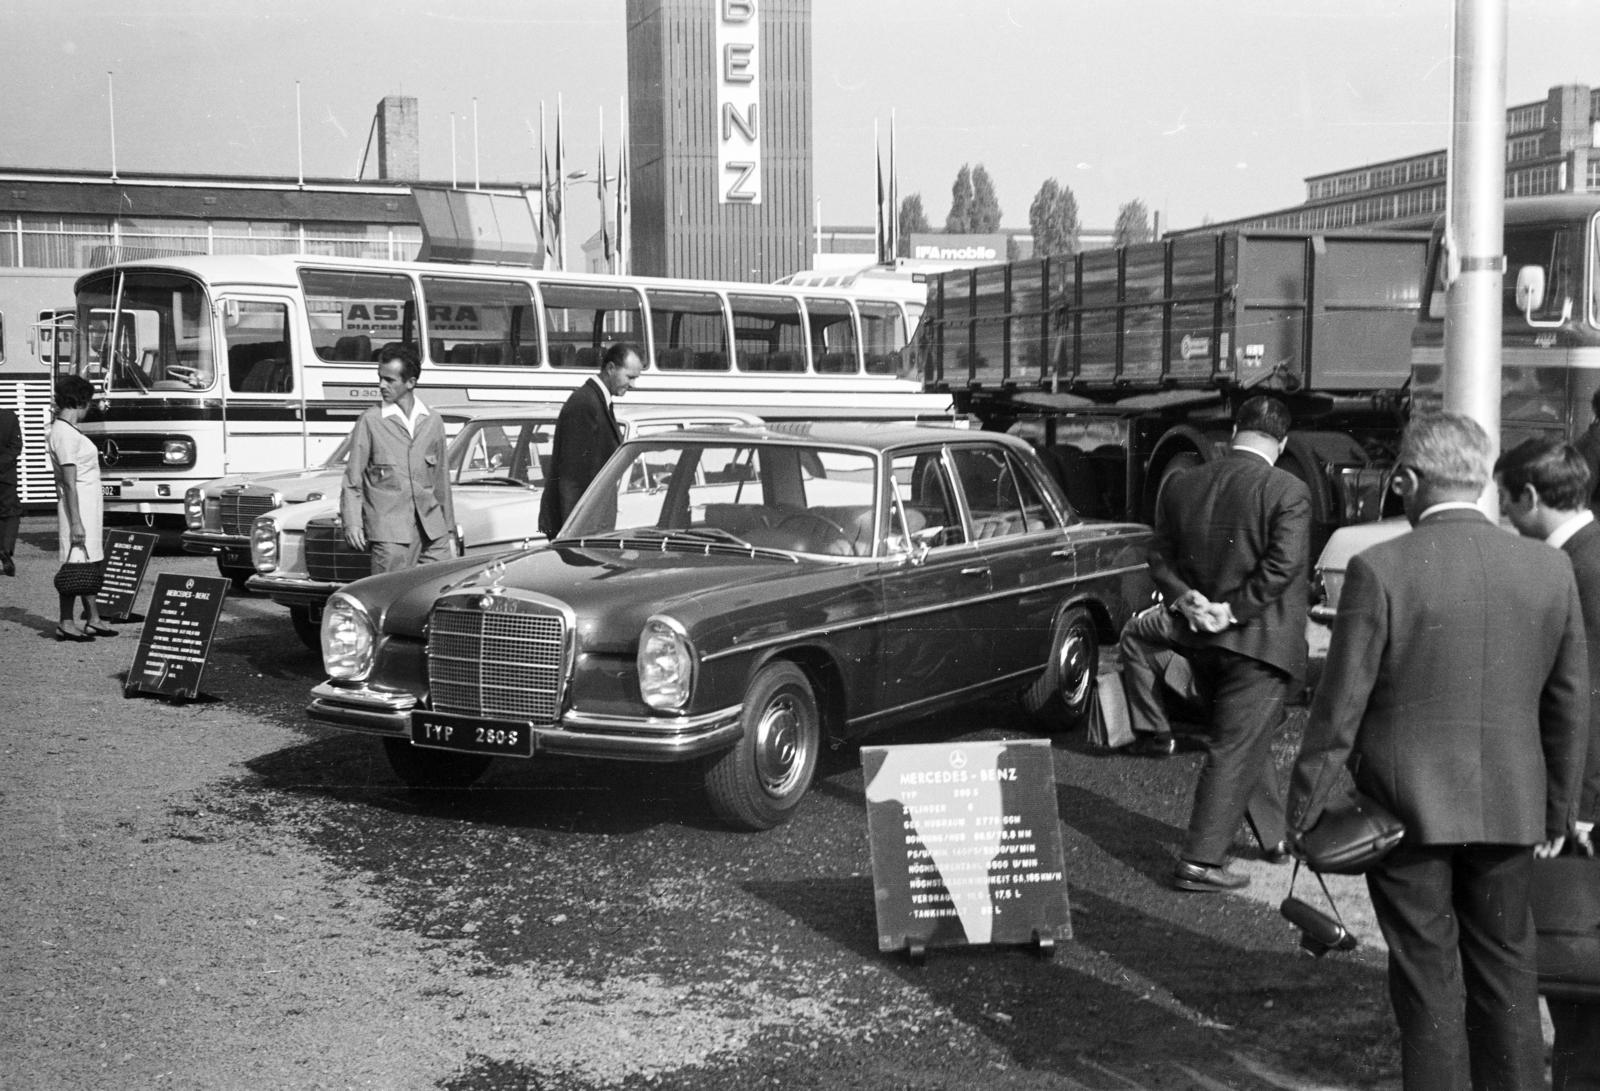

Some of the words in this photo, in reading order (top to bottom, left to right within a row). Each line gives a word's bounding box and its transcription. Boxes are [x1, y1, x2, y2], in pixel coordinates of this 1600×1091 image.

[347, 304, 478, 321] ASRA
[362, 389, 381, 397] 30
[424, 723, 453, 741] TYP
[900, 770, 968, 785] MERCEDES
[980, 768, 1018, 782] BENZ
[901, 790, 917, 800] TYP
[903, 804, 947, 814] ZYLINDER
